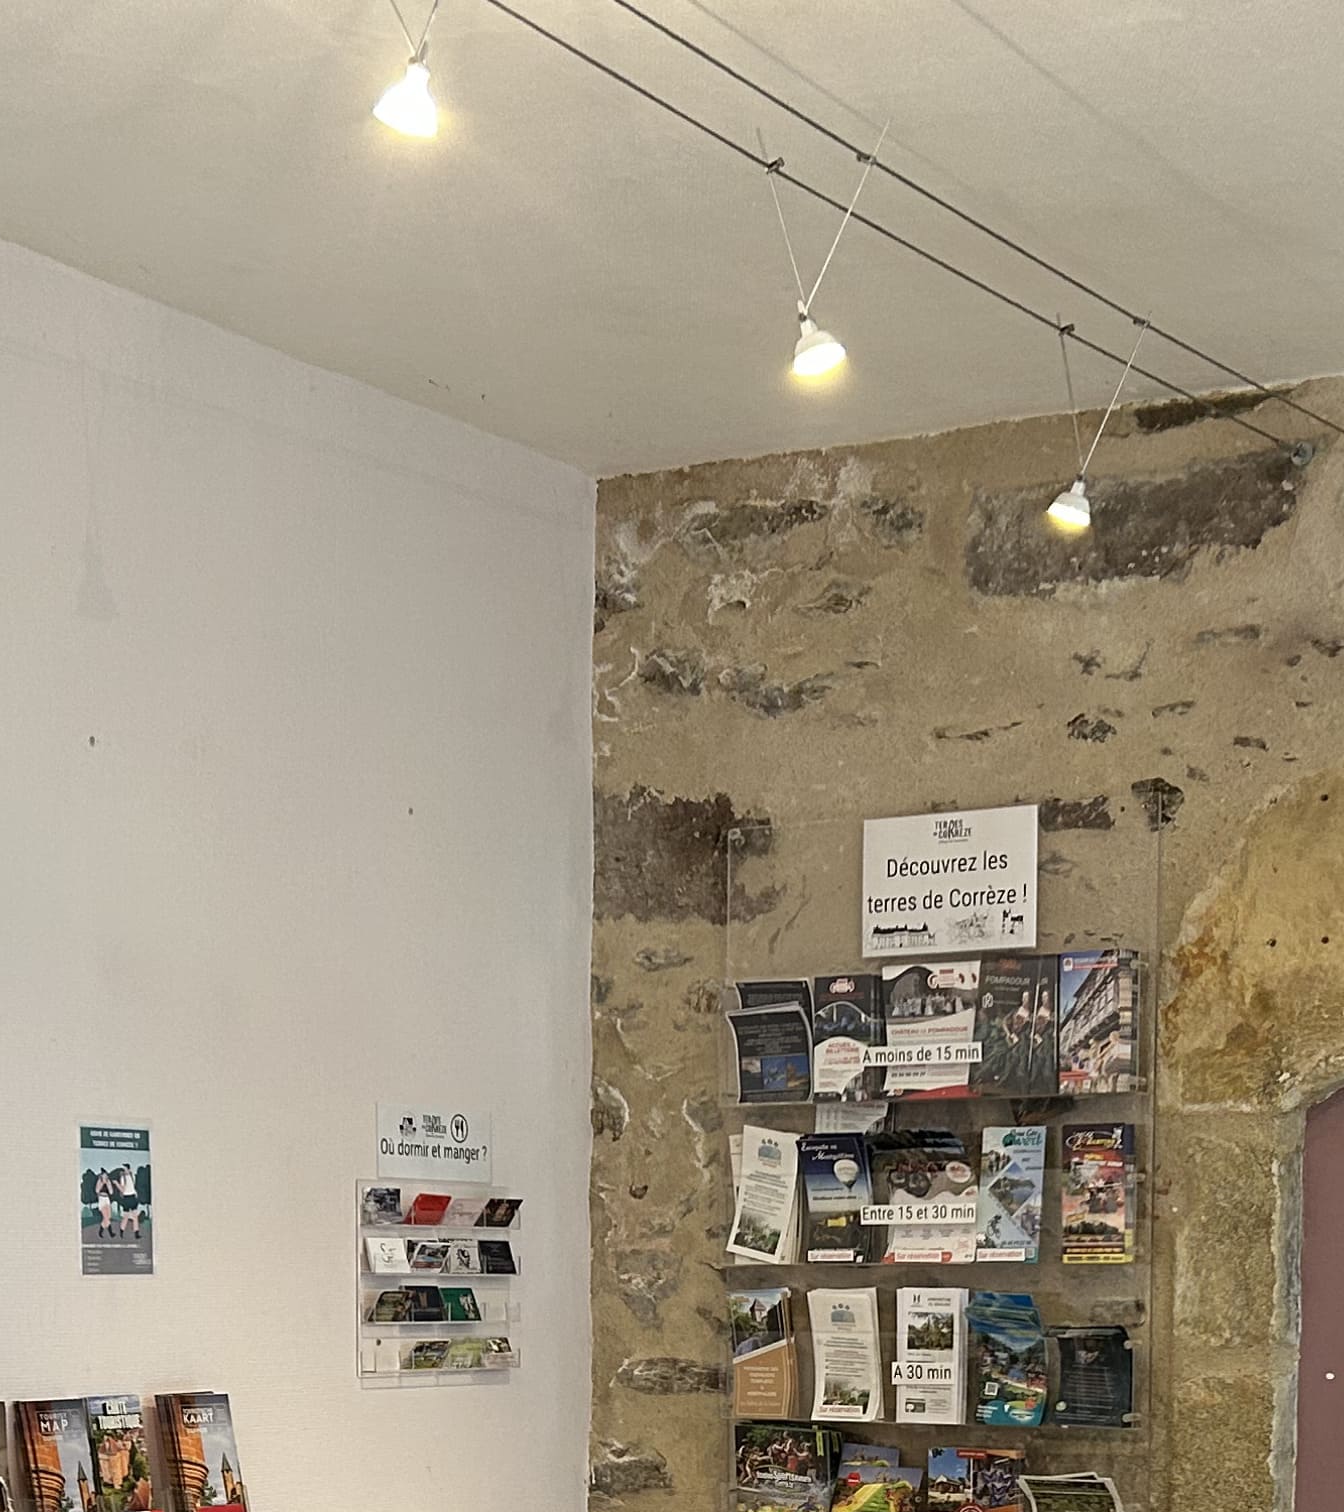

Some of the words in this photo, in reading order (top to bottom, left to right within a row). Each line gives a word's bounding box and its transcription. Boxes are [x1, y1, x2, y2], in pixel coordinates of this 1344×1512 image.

[887, 856, 977, 878] Découvrez
[983, 850, 1008, 870] les
[868, 895, 917, 913] terres
[923, 890, 943, 909] de
[950, 885, 1017, 907] Corrèze
[1023, 884, 1027, 903] !
[875, 1048, 912, 1063] moins
[916, 1047, 932, 1062] de
[936, 1047, 952, 1061] 15
[955, 1046, 980, 1060] min
[380, 1138, 395, 1155] Où
[398, 1140, 429, 1158] dormir
[432, 1142, 441, 1158] et
[444, 1144, 479, 1164] manger
[482, 1146, 487, 1161] ?
[862, 1206, 894, 1221] Entre
[898, 1206, 912, 1219] 15
[916, 1206, 928, 1220] et
[932, 1206, 946, 1219] 30
[951, 1206, 974, 1218] min
[894, 1366, 902, 1379] A
[906, 1365, 922, 1379] 30
[928, 1364, 951, 1380] min
[40, 1419, 68, 1432] MAP
[183, 1413, 214, 1424] KAART
